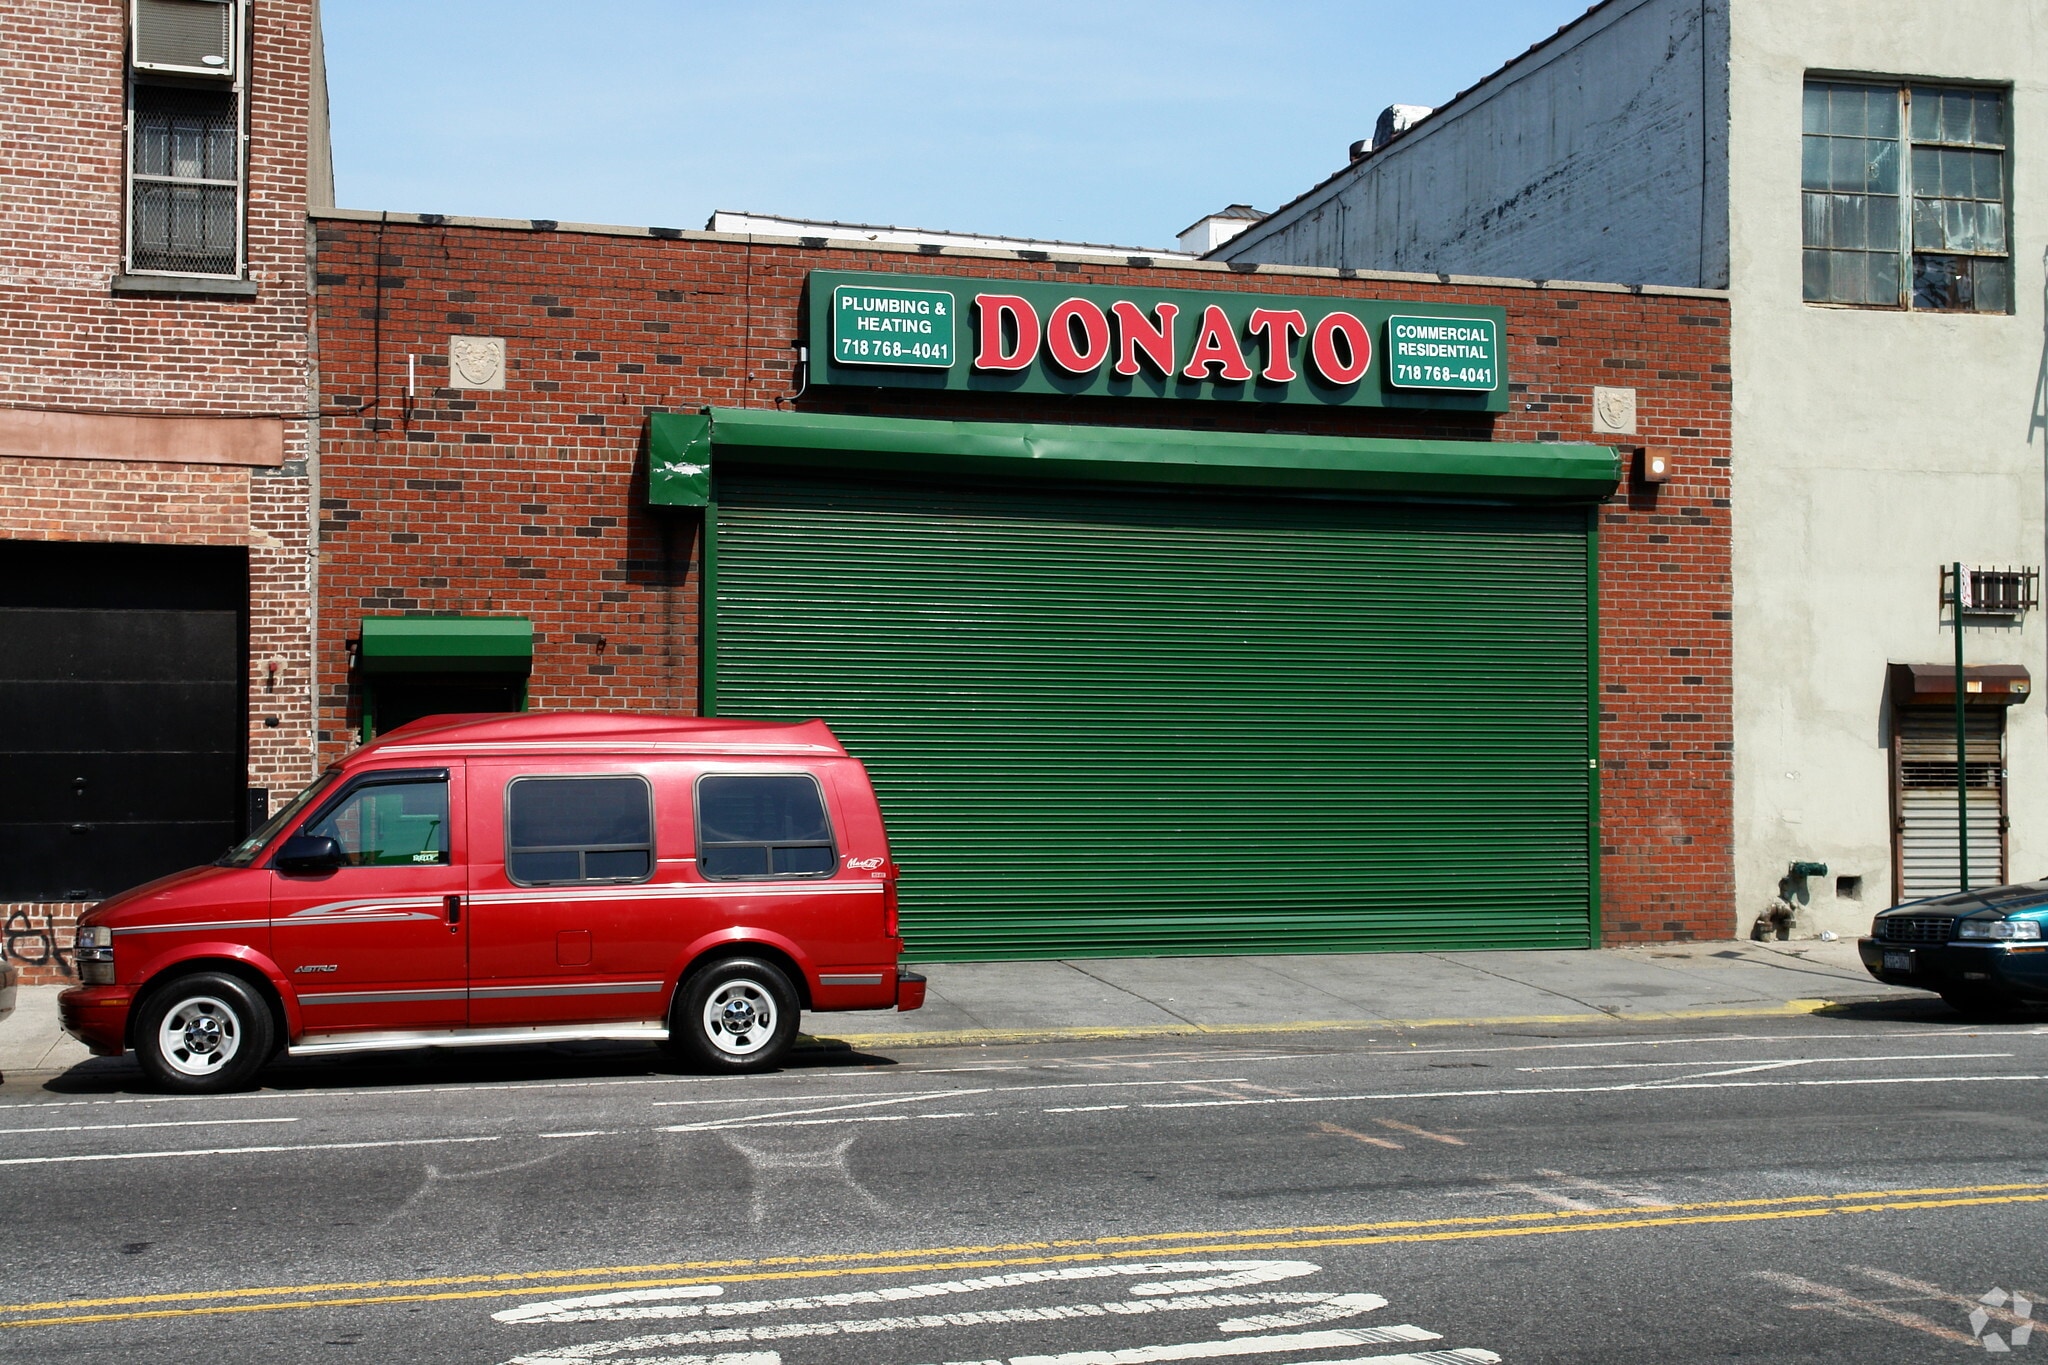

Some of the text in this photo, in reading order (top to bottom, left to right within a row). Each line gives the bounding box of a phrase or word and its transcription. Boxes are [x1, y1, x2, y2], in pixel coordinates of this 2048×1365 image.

[842, 296, 947, 316] PLUMBING &
[857, 316, 932, 334] HEATING
[1396, 325, 1489, 342] COMMERCIAL
[975, 292, 1373, 385] DONATO
[842, 338, 948, 359] 718 768-4041
[1398, 342, 1488, 359] RESIDENTIAL
[1397, 364, 1491, 383] 718 768-4041
[294, 964, 338, 973] ASTRO
